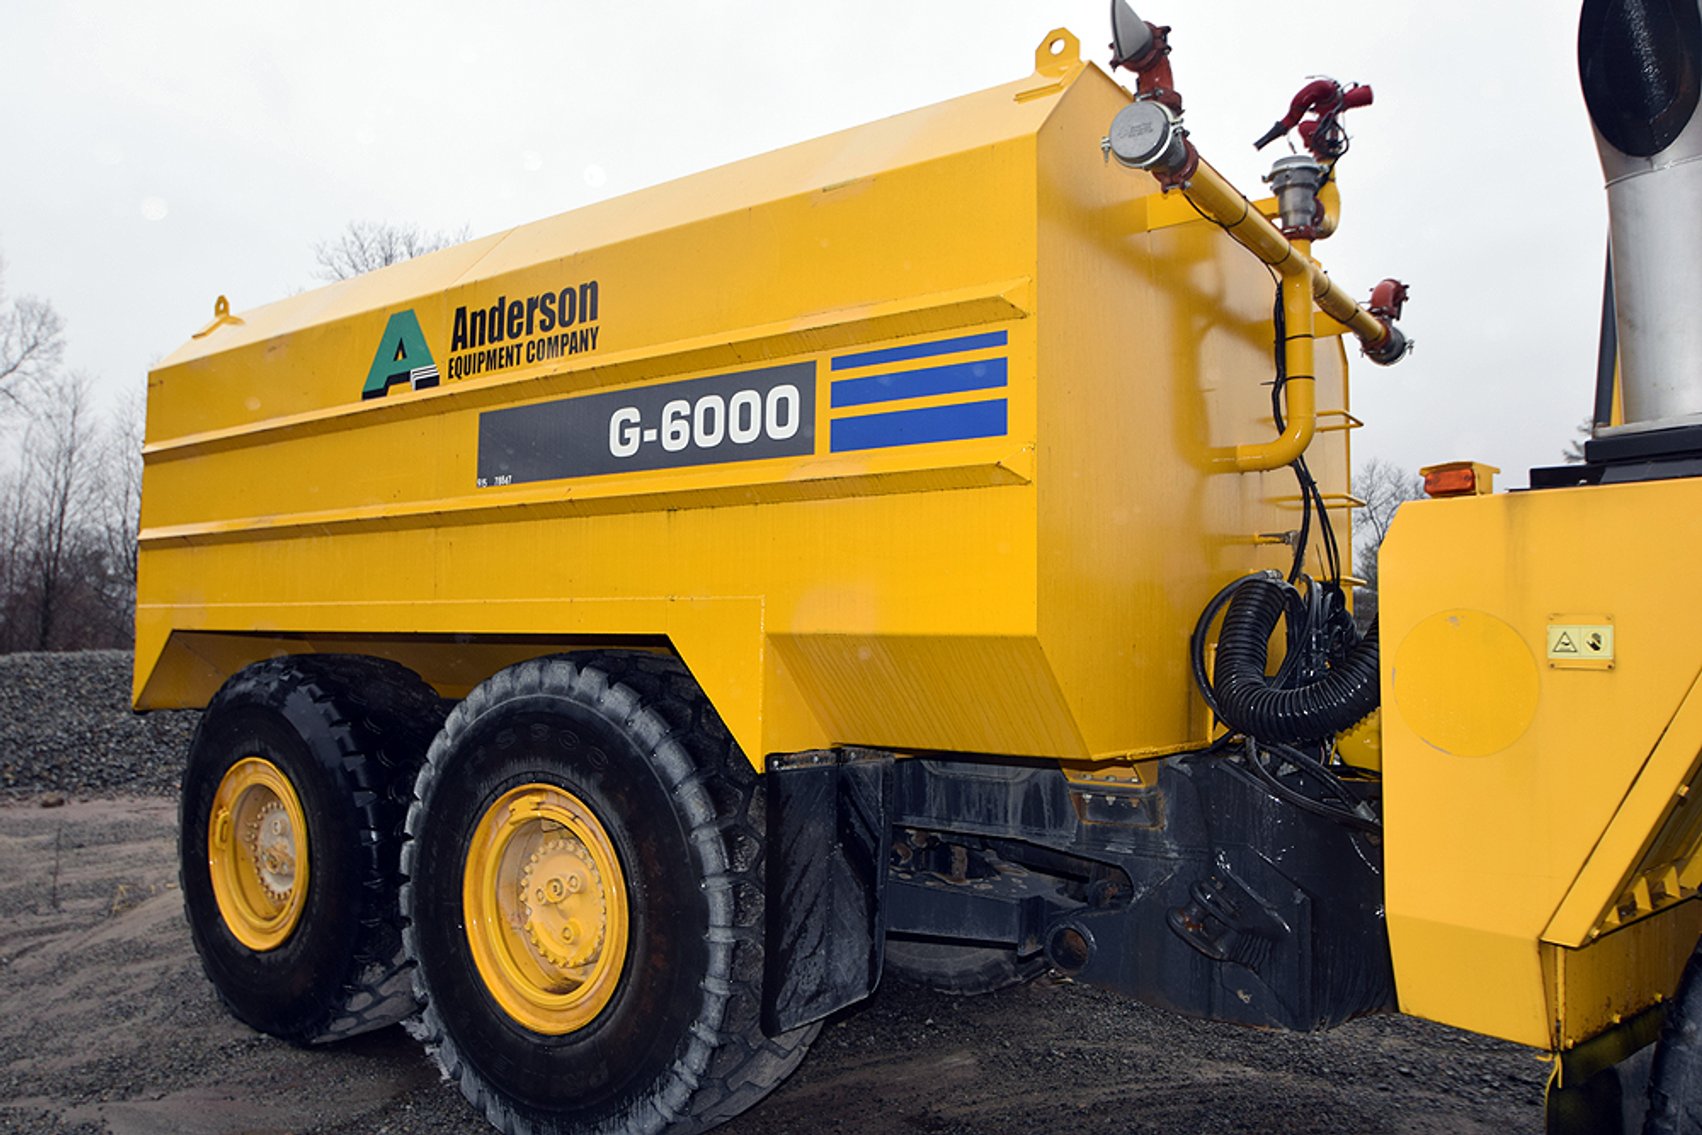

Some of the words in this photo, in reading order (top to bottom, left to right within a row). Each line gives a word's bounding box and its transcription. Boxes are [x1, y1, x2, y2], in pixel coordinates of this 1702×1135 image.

[451, 280, 599, 352] Anderson
[447, 343, 523, 380] EQUIPMENT
[526, 326, 600, 363] COMPANY
[608, 384, 800, 458] G-6000
